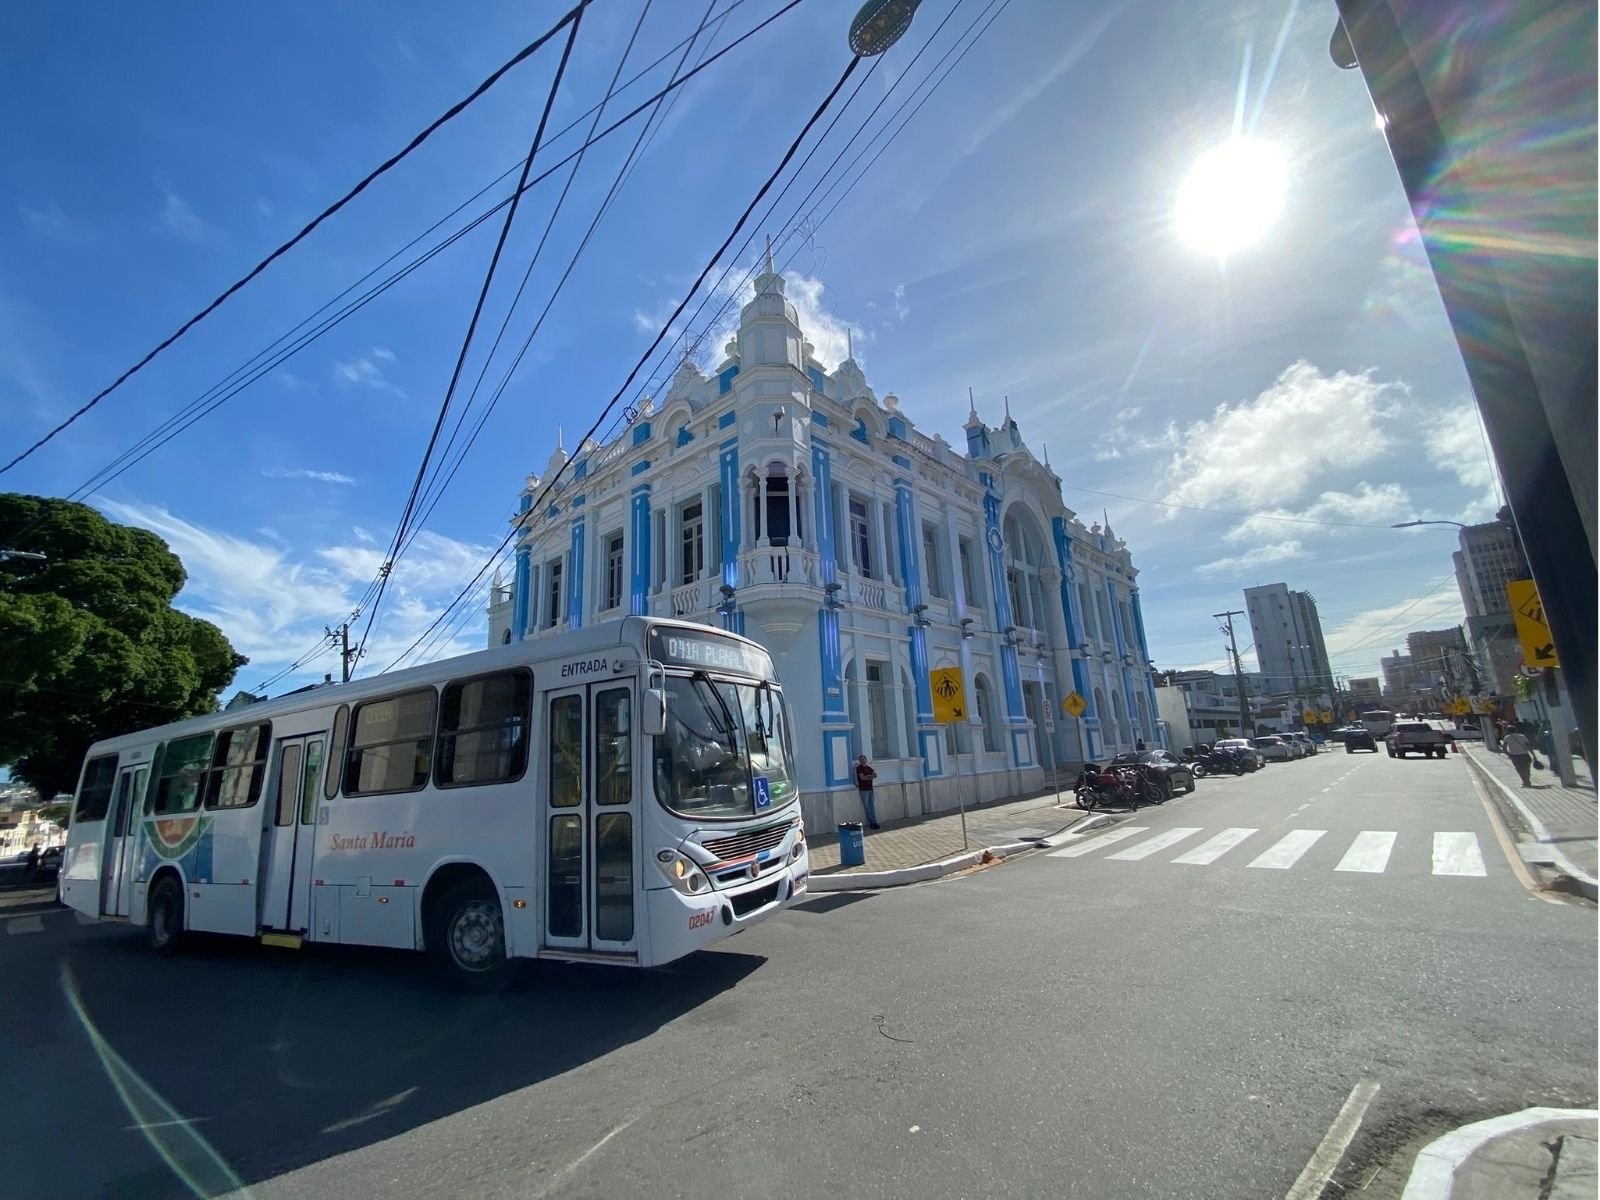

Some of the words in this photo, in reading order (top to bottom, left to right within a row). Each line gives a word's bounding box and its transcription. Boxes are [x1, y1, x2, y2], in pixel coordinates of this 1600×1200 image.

[668, 638, 700, 660] 041A
[561, 659, 607, 678] ENTRADA
[330, 832, 367, 851] Santa
[371, 830, 415, 849] Maria
[689, 910, 715, 930] 02047
